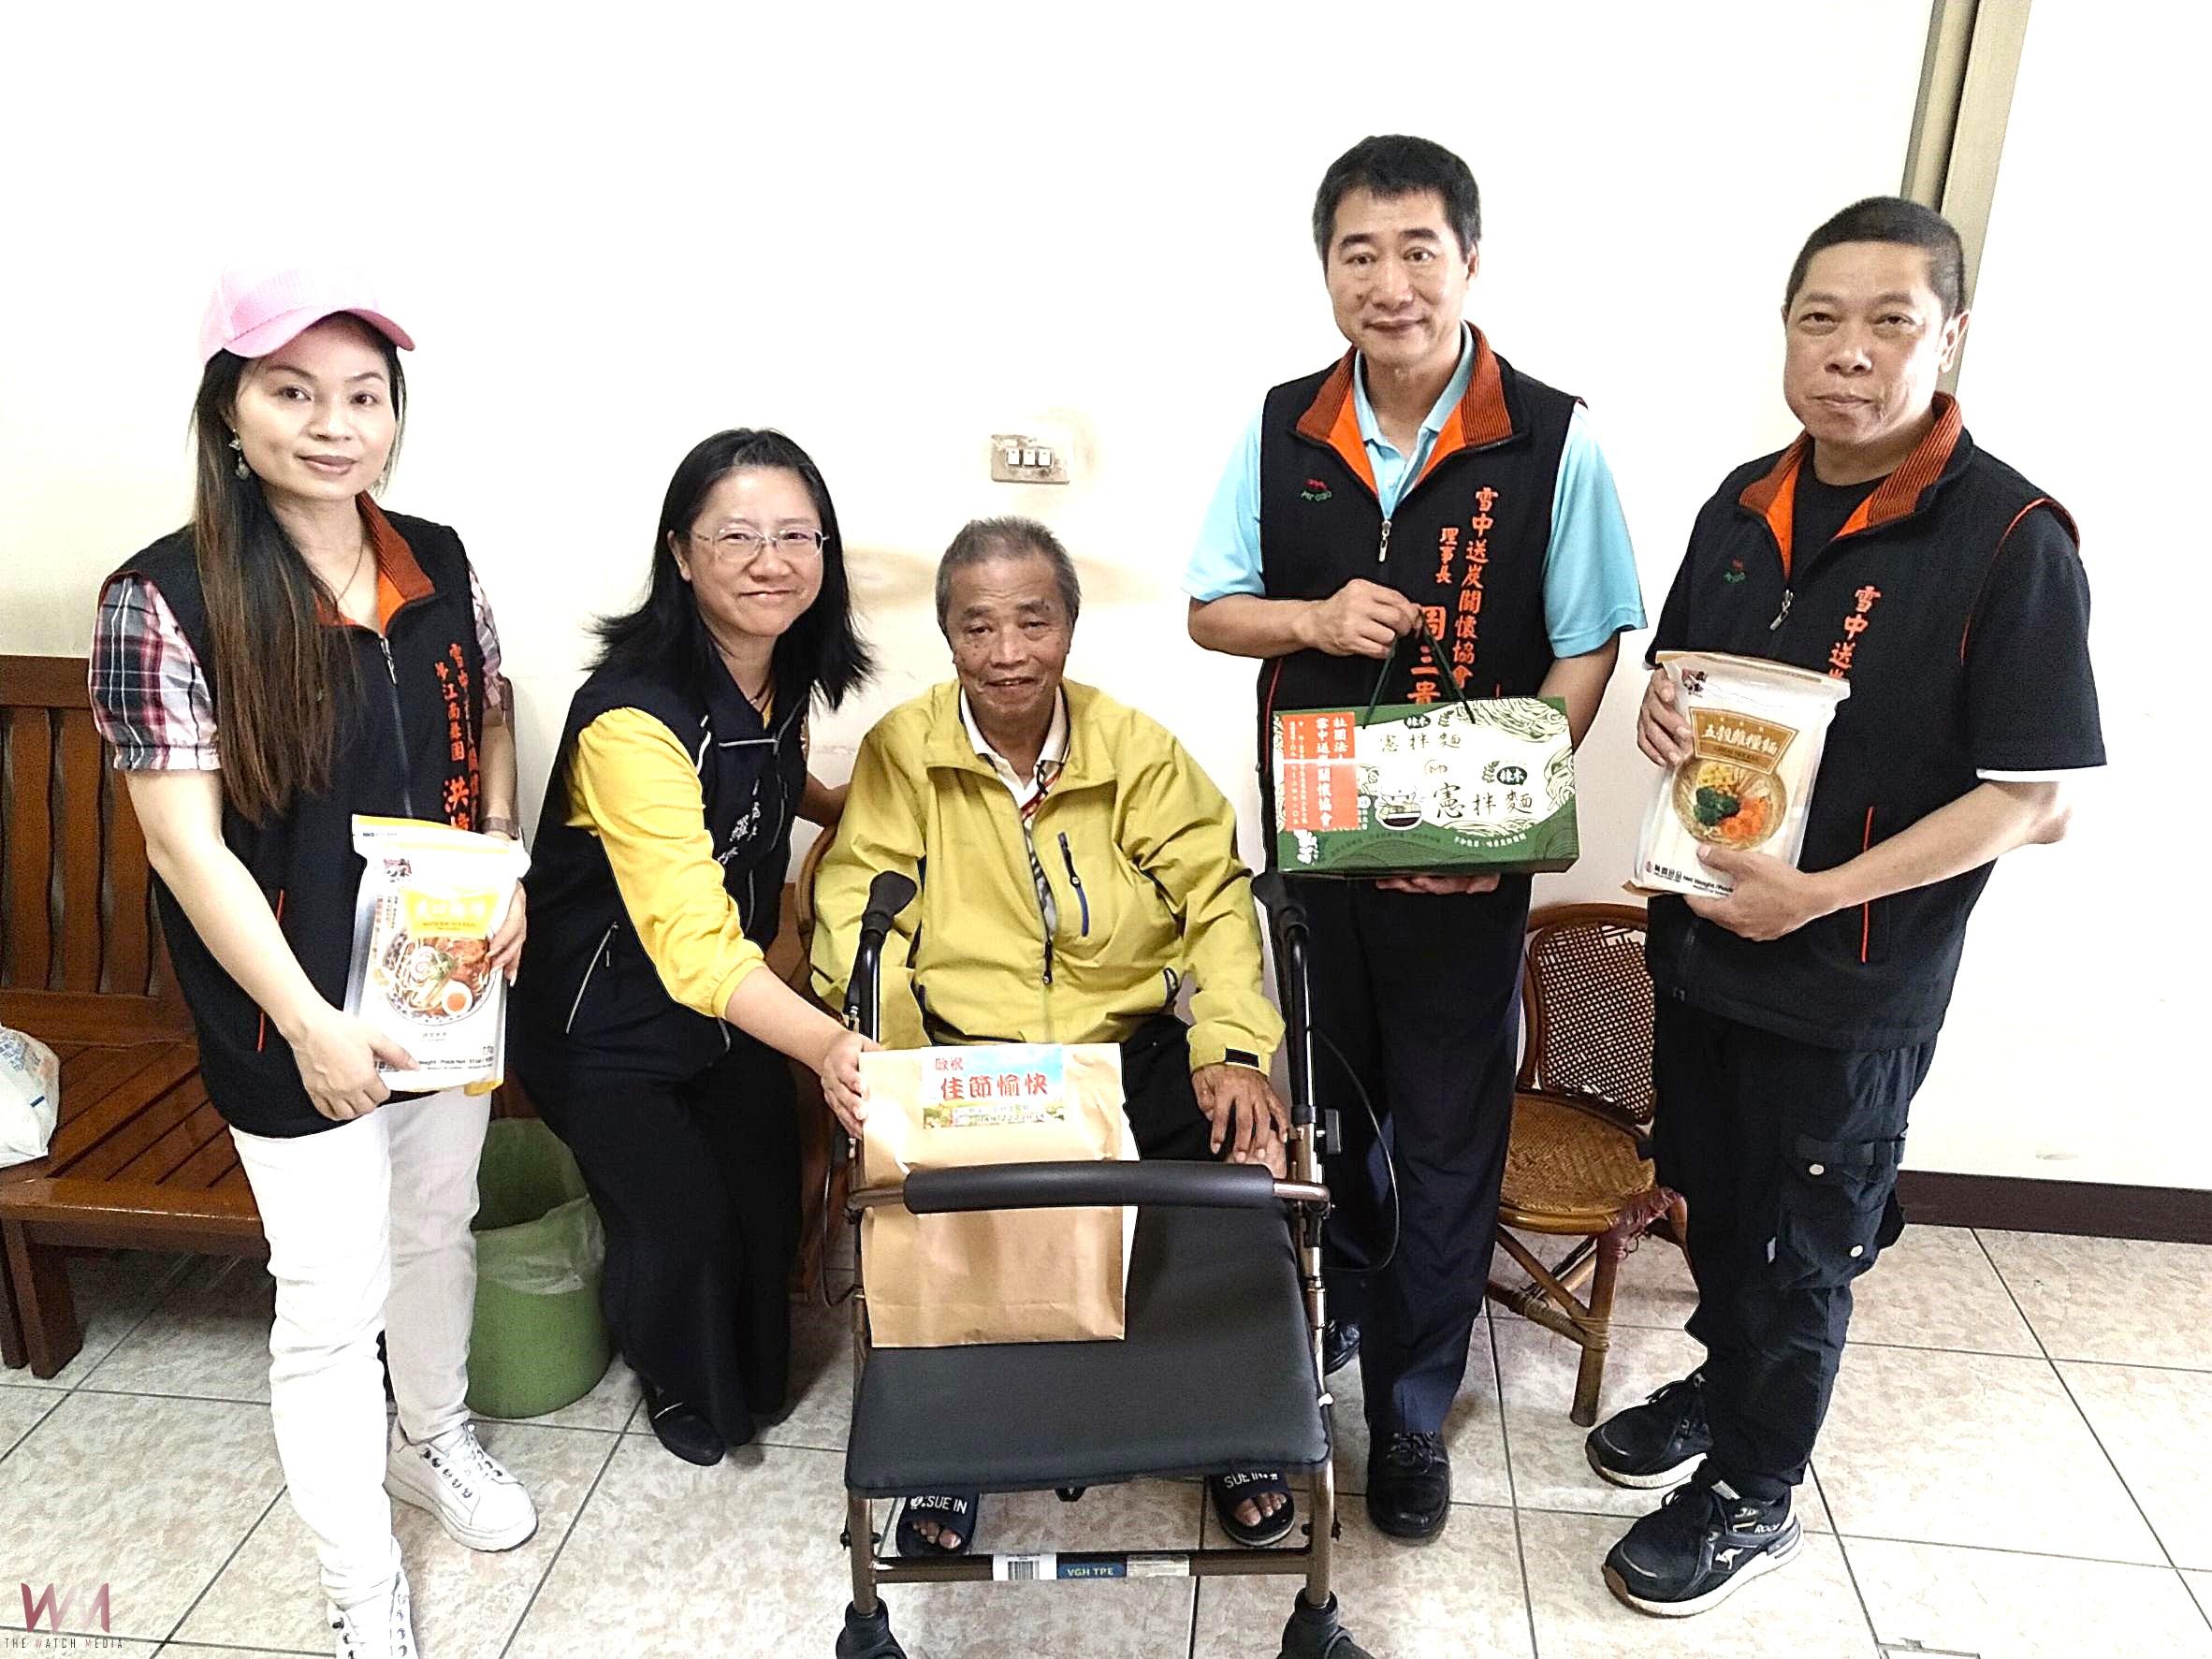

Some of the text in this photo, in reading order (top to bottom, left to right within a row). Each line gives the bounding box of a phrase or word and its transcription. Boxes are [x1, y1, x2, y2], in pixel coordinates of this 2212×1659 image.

[1435, 527, 1460, 584] 理事長
[1452, 487, 1498, 688] 雪中送炭關懷協會
[1316, 717, 1332, 827] 雪中送關懷協會
[1433, 781, 1533, 819] 憲拌麵
[941, 1072, 1048, 1100] 佳節愉快
[953, 1498, 968, 1515] IN
[1067, 1566, 1114, 1577] VGH TPE
